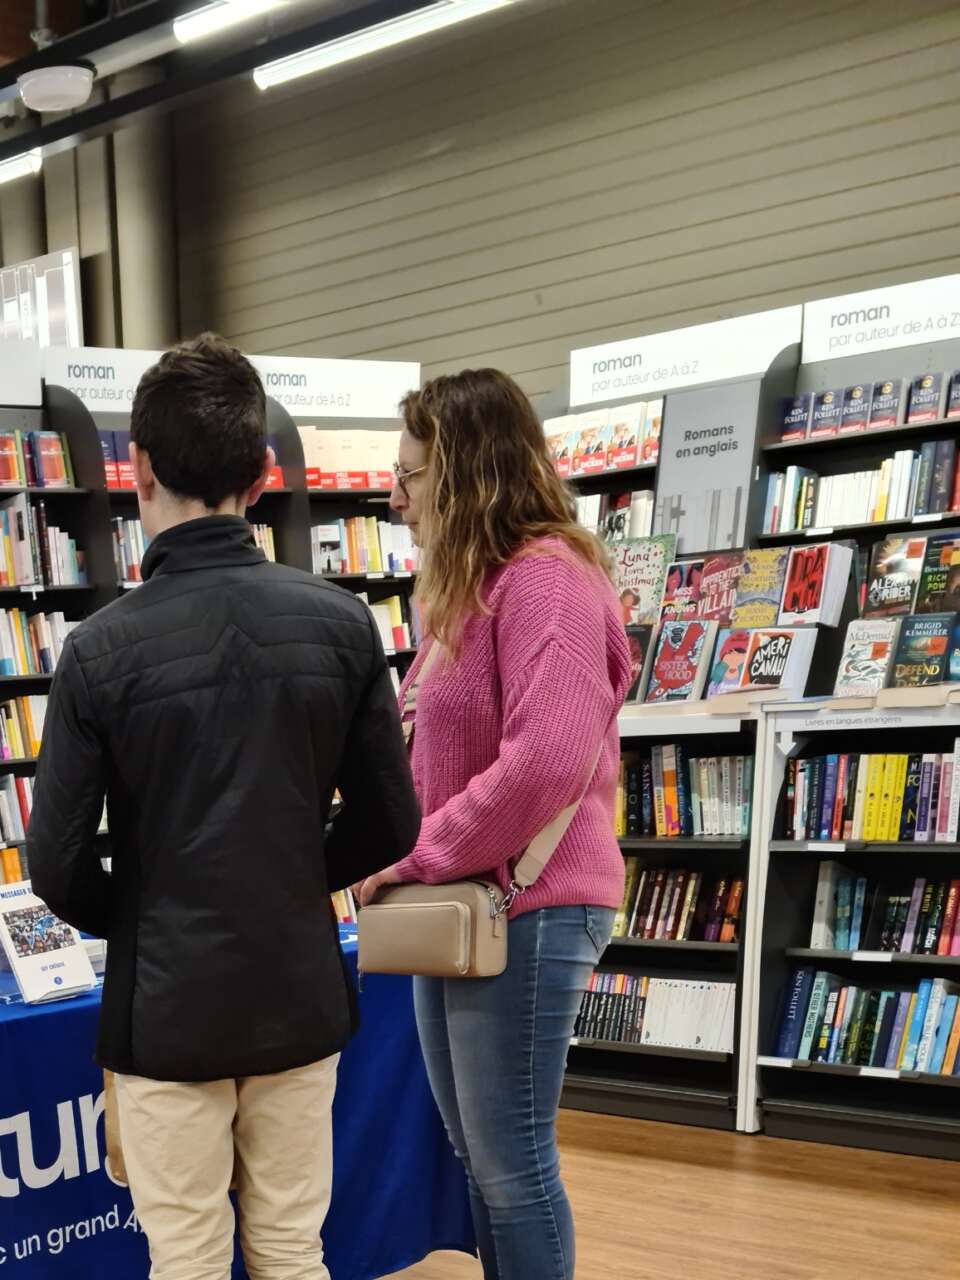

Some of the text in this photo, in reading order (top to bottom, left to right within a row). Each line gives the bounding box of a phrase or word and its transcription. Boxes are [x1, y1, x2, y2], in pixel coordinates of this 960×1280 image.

[830, 304, 890, 329] roman
[828, 334, 852, 352] par
[854, 324, 900, 343] auteur
[902, 320, 922, 335] de
[924, 317, 934, 331] A
[937, 315, 948, 328] à
[67, 363, 115, 379] roman
[592, 353, 642, 374] roman
[266, 372, 307, 387] roman
[591, 360, 701, 396] par auteur de A à Z
[89, 386, 124, 400] auteur
[284, 393, 313, 406] auteur
[316, 393, 328, 406] de
[329, 394, 336, 406] A
[345, 394, 351, 407] Z
[684, 425, 734, 441] Romans
[676, 439, 739, 458] en anglais
[619, 549, 650, 568] Luna
[618, 576, 655, 588] hristmas
[914, 622, 942, 630] BRIGID
[659, 661, 689, 671] SISTER
[895, 663, 940, 677] DEFEND
[663, 670, 692, 680] HOOD
[13, 1233, 42, 1259] un
[46, 1204, 120, 1255] grand
